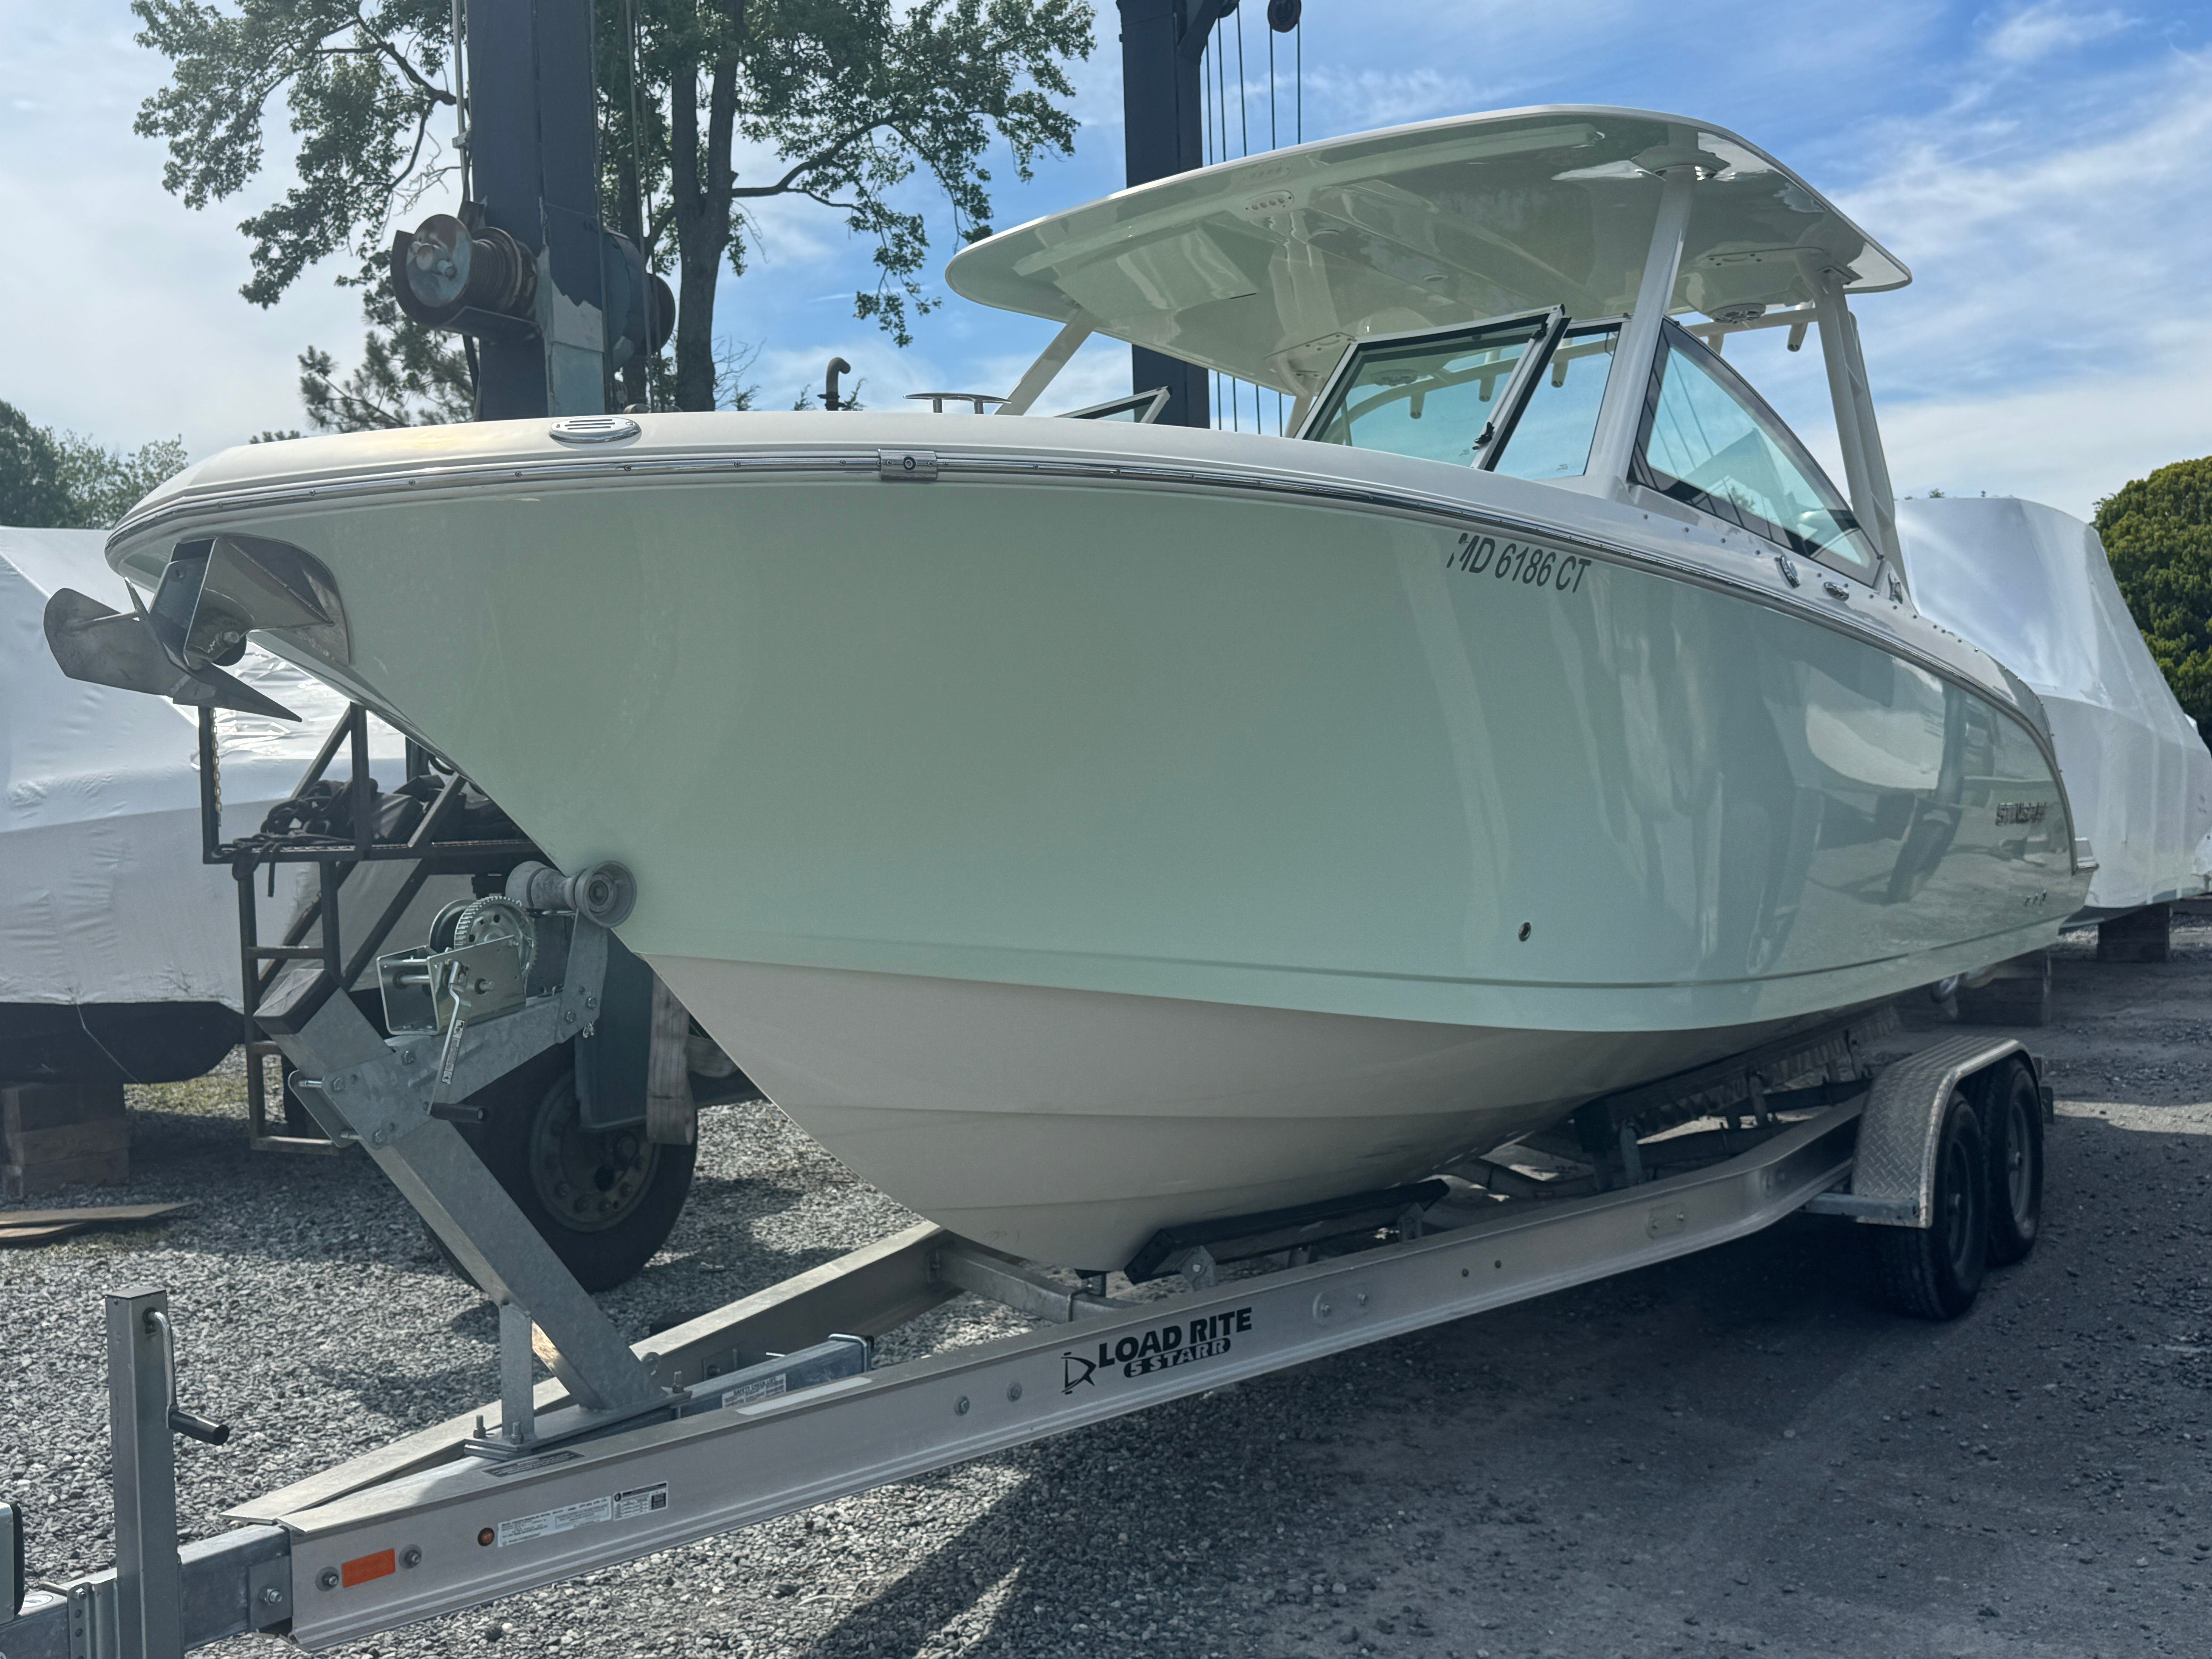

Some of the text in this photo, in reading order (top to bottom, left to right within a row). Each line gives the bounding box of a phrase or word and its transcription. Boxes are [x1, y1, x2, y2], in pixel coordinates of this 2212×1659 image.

[1495, 543, 1556, 587] 6186
[1556, 556, 1592, 593] CT
[1099, 1307, 1252, 1368] LOAD RITE
[1130, 1339, 1226, 1376] 5 STARR
